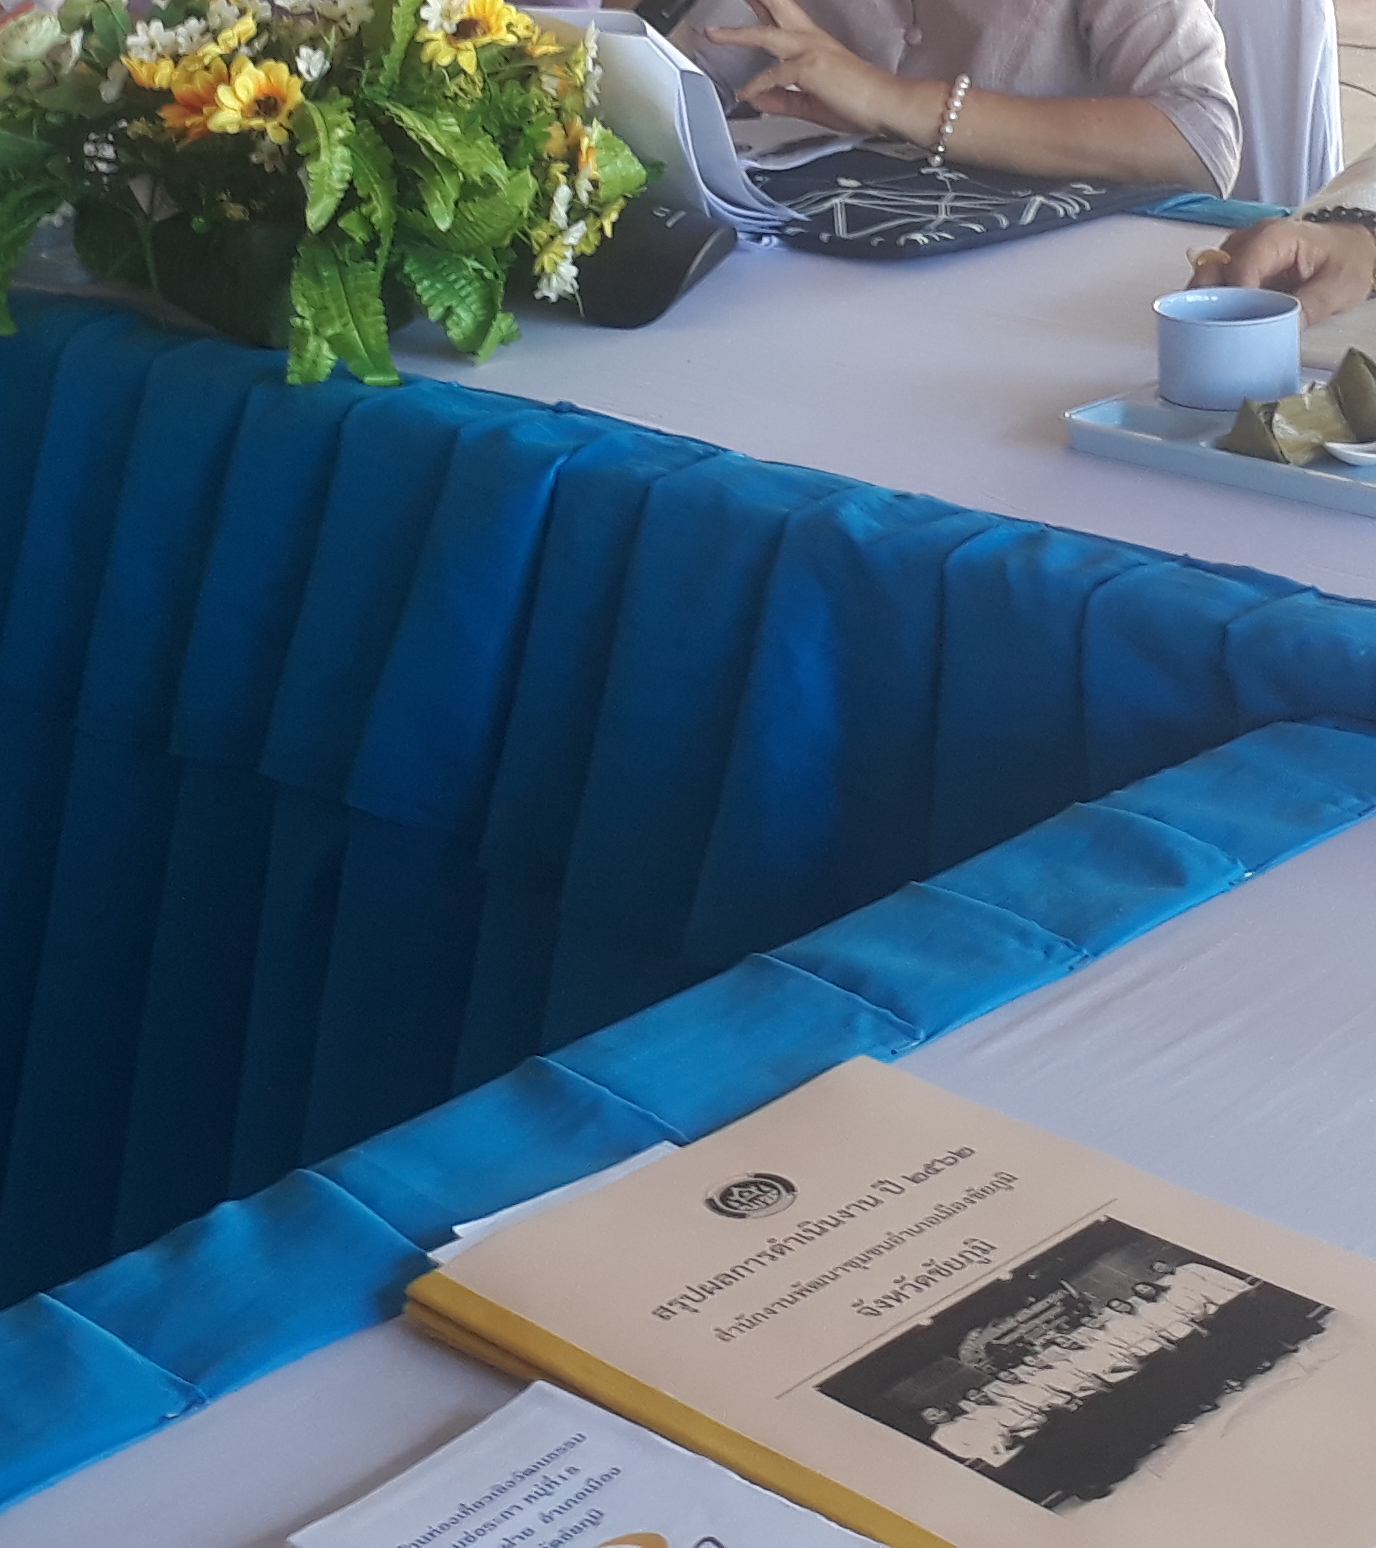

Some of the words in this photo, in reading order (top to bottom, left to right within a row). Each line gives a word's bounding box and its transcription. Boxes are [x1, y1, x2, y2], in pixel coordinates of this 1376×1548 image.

[650, 1191, 884, 1322] สรุปผลการดำเนินงาน
[878, 1176, 907, 1198] ปี
[901, 1144, 978, 1188] ๒๕๖๒
[713, 1170, 1019, 1344] สำนักงานพัฒนาชุมชนอำเภอเมืองชัยภูมิ
[853, 1237, 998, 1320] จังหวัดชัยภูมิ
[538, 1466, 622, 1524] อำเภอเมือง
